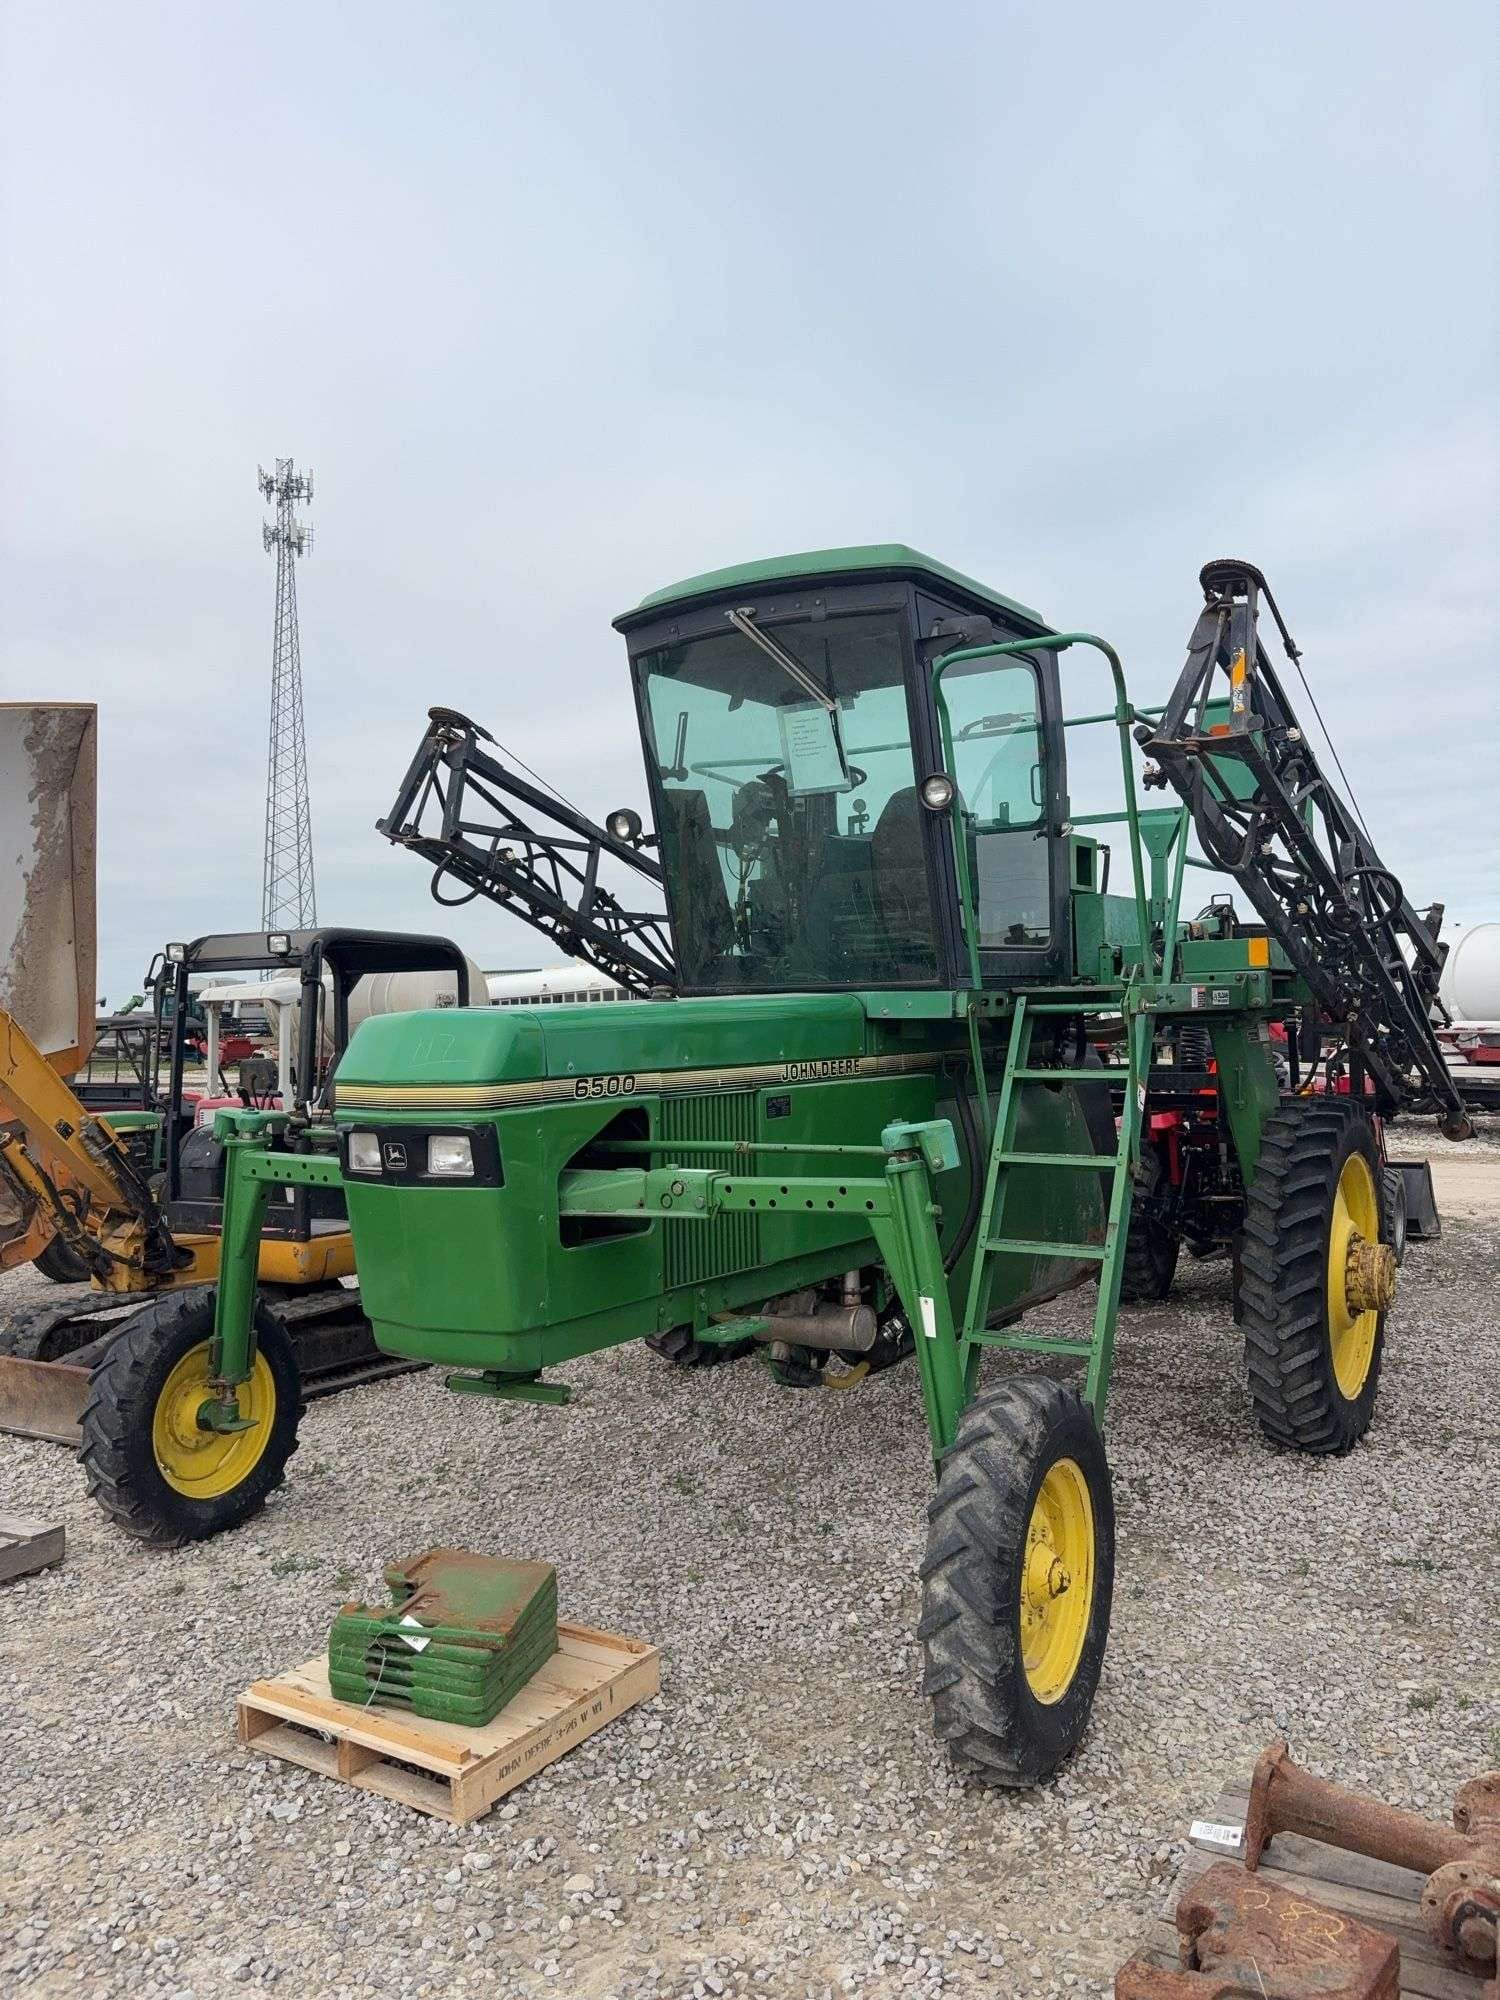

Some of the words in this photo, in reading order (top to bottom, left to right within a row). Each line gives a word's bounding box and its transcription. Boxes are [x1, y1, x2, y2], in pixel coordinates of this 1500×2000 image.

[781, 1063, 818, 1082] JOHN
[821, 1059, 862, 1077] DEERE
[574, 1075, 637, 1099] 6500
[496, 1755, 522, 1781] JOHN
[524, 1734, 553, 1762] DEERE
